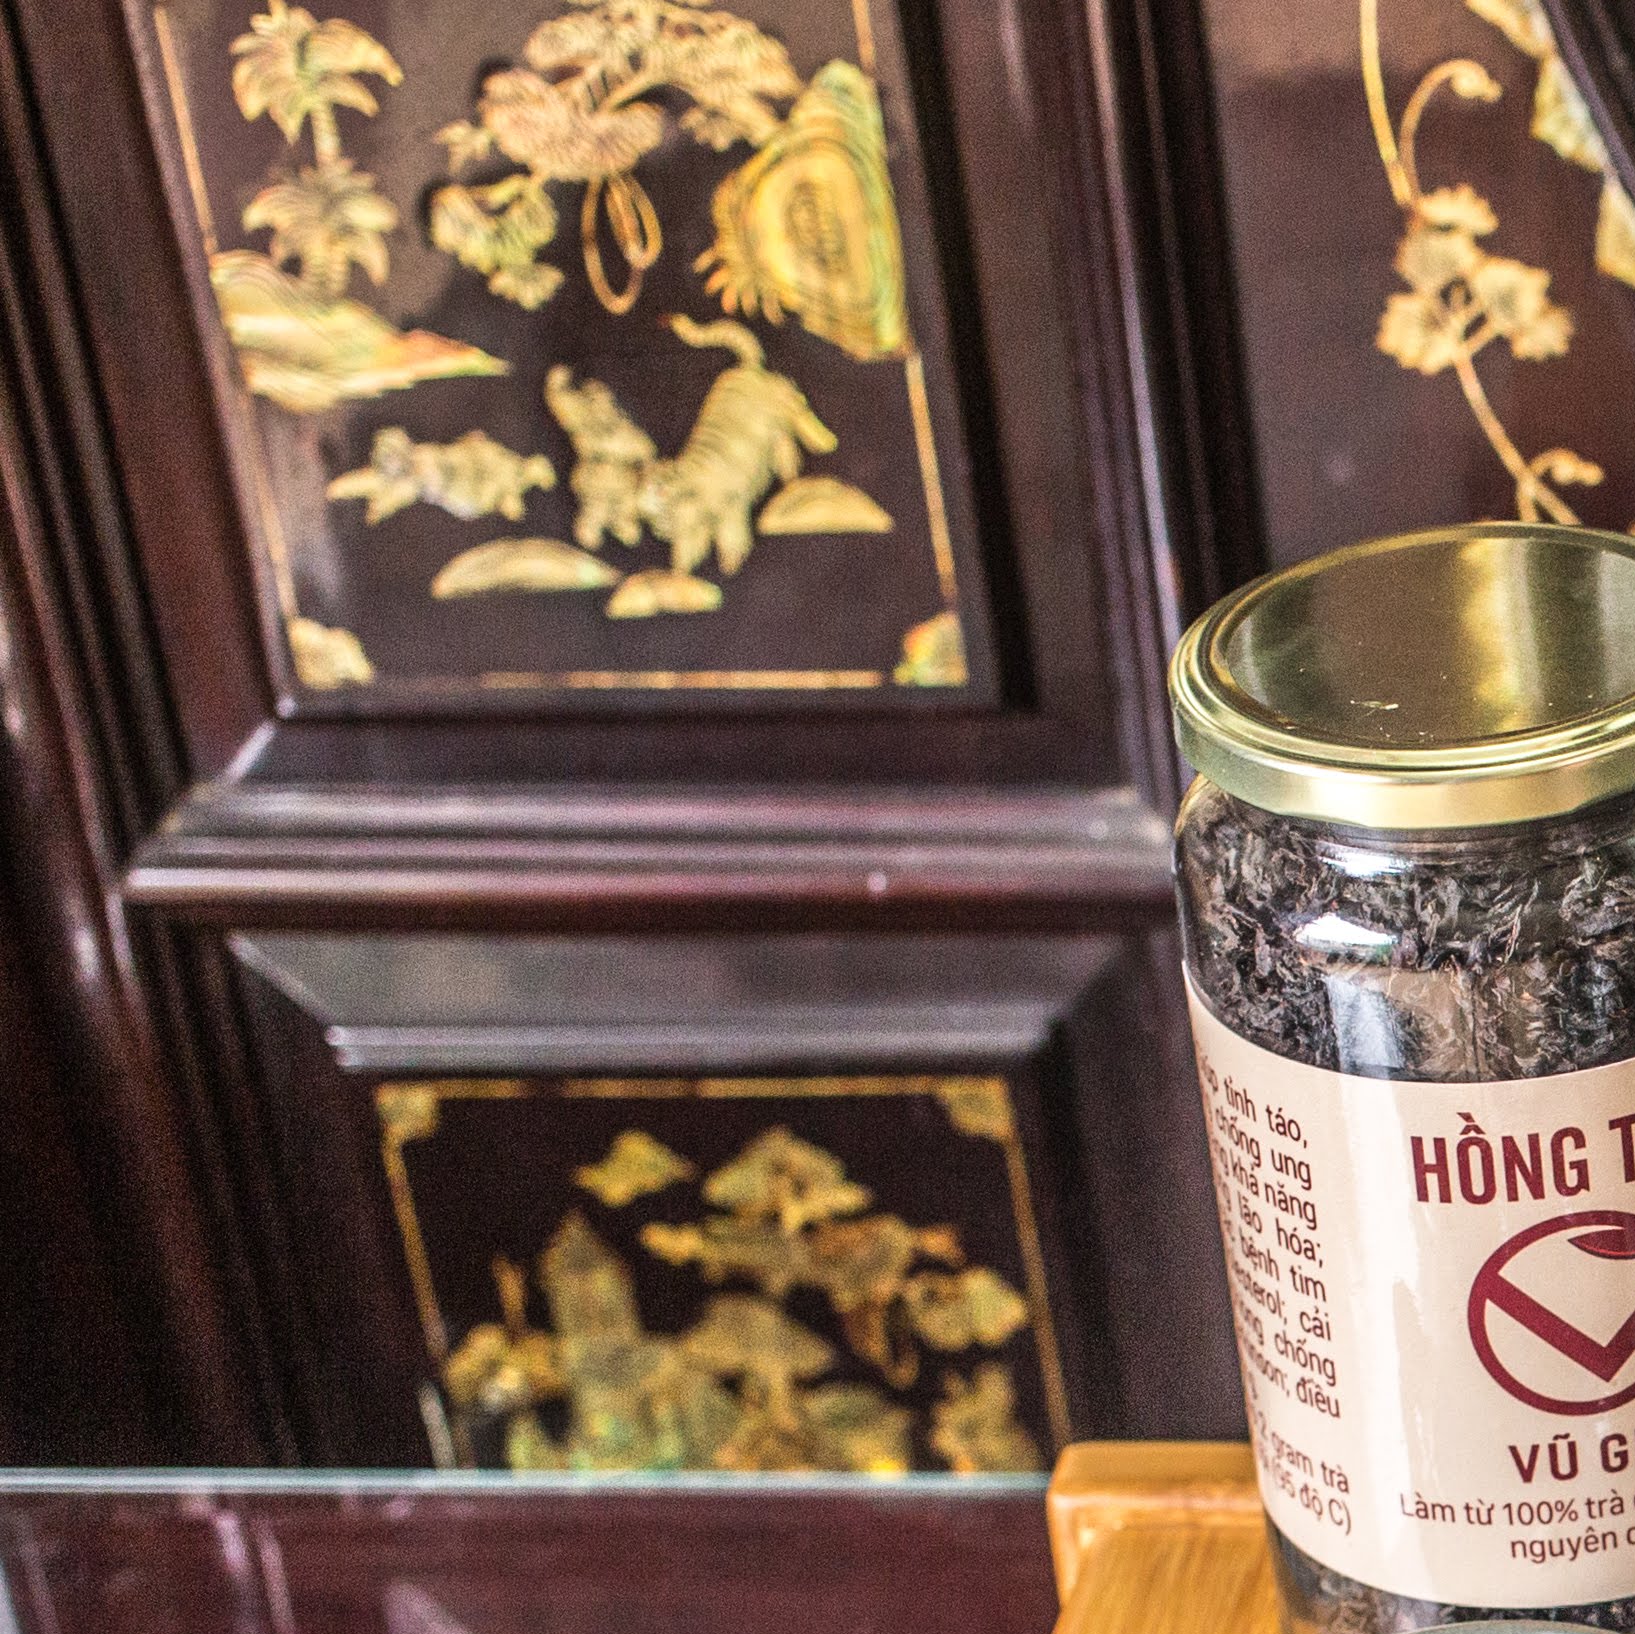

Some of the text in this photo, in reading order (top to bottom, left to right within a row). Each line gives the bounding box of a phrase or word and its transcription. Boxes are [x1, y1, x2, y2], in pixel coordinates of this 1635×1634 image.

[1265, 1104, 1308, 1149] táo,
[1271, 1149, 1312, 1191] ung
[1410, 1112, 1590, 1206] HỒNG
[1264, 1181, 1317, 1230] năng
[1275, 1218, 1323, 1268] hóa;
[1290, 1265, 1327, 1302] tim
[1300, 1306, 1331, 1341] cải
[1274, 1330, 1337, 1387] chống
[1296, 1376, 1341, 1419] điều
[1321, 1461, 1350, 1494] trà
[1508, 1433, 1580, 1484] VŨ
[1300, 1482, 1323, 1522] độ
[1328, 1498, 1351, 1536] C)
[1400, 1492, 1456, 1523] Làm
[1464, 1500, 1495, 1526] từ
[1503, 1500, 1579, 1526] 100%
[1585, 1489, 1625, 1519] trà
[1511, 1528, 1618, 1564] nguyên
